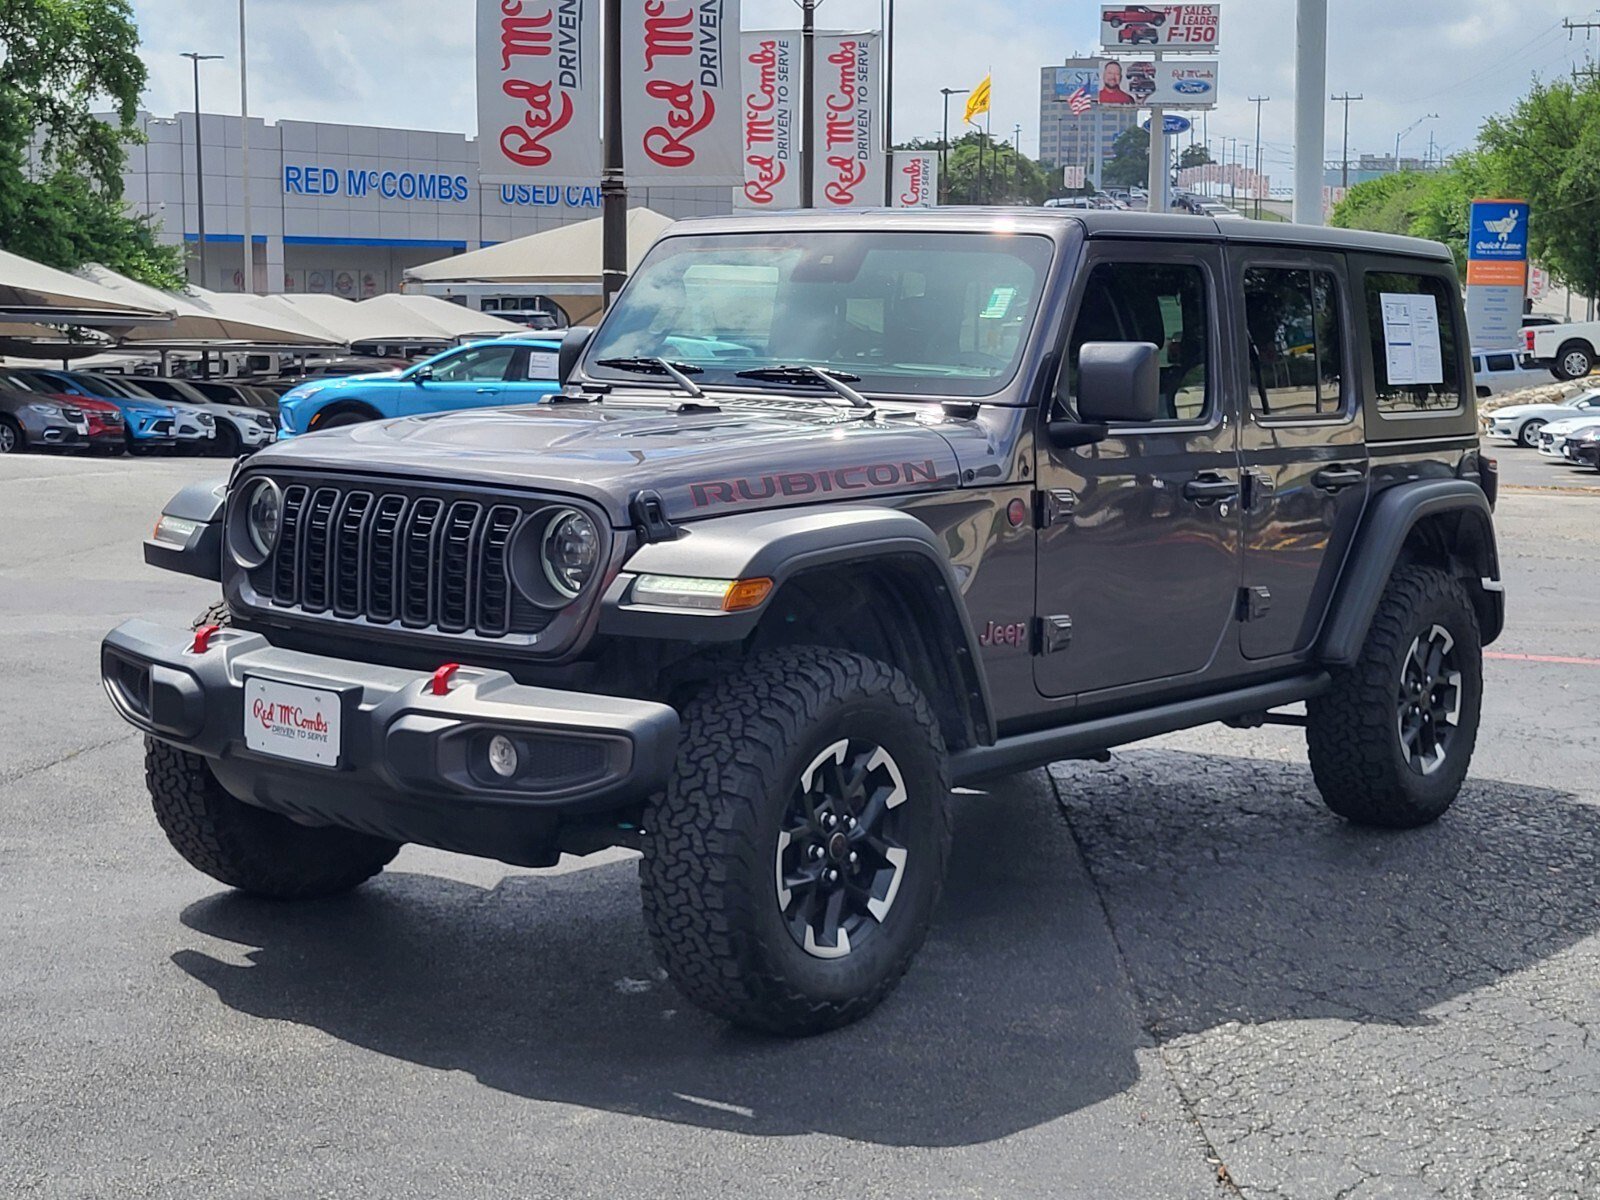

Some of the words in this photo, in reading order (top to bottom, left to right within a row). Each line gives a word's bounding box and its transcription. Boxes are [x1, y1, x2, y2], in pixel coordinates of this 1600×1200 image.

[1163, 5, 1183, 26] #1
[1182, 15, 1218, 26] LEADER
[1184, 6, 1212, 16] SALES
[558, 0, 577, 89] DRIVEN
[700, 0, 718, 88] DRIVEN
[1166, 26, 1216, 43] F-150
[777, 40, 789, 82] SERVE
[858, 41, 869, 83] SERVE
[777, 86, 789, 105] TO
[858, 86, 869, 104] TO
[1180, 82, 1206, 94] Ford
[500, 79, 574, 167] Red
[643, 79, 716, 168] Red
[777, 108, 789, 160] DRIVEN
[858, 109, 869, 160] DRIVEN
[284, 165, 340, 195] RED
[744, 154, 786, 205] Red
[825, 155, 866, 205] Red
[900, 158, 921, 206] Combs
[921, 158, 930, 186] SERVE
[502, 184, 560, 205] USED
[1476, 241, 1500, 251] Quick
[1501, 241, 1522, 250] Lane
[689, 460, 938, 508] RUBICON
[979, 620, 1027, 648] Jeep
[253, 698, 275, 729] Red
[271, 724, 296, 738] DRIVEN
[297, 730, 306, 739] TO
[307, 731, 329, 743] SERVE
